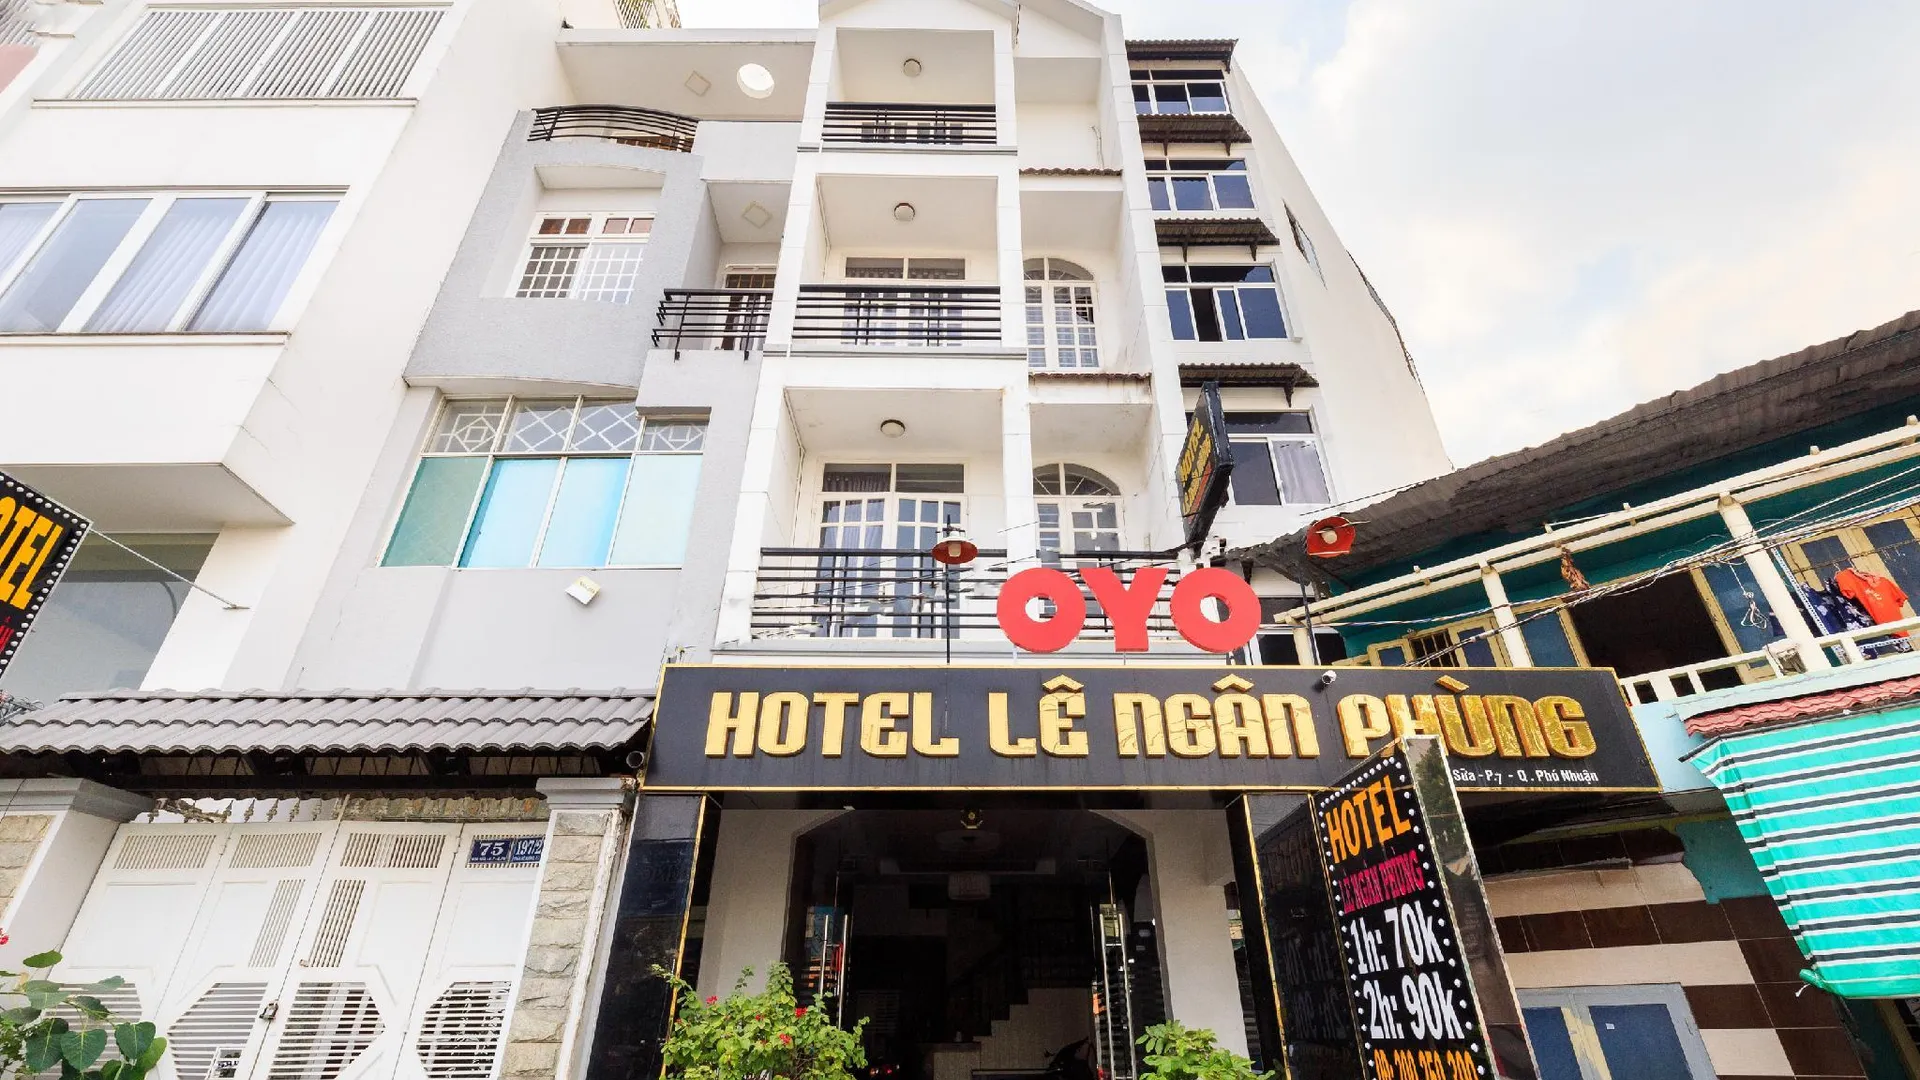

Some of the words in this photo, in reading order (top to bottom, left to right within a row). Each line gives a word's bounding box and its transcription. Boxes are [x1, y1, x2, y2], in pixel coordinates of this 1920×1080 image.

[0, 496, 64, 610] TEL
[997, 567, 1261, 653] OYO
[705, 691, 960, 758] HOTEL
[987, 674, 1089, 759] LÊ
[1113, 673, 1320, 759] NGÂN
[1337, 675, 1597, 759] PHÙNG
[1535, 768, 1560, 782] Phú
[1561, 769, 1599, 784] Nhuận
[480, 842, 505, 856] 75
[1325, 775, 1411, 863] HOTEL
[1350, 917, 1389, 974] 1h:
[1384, 900, 1445, 968] 70k
[1363, 979, 1405, 1039] 2h:
[1401, 971, 1465, 1040] 90k
